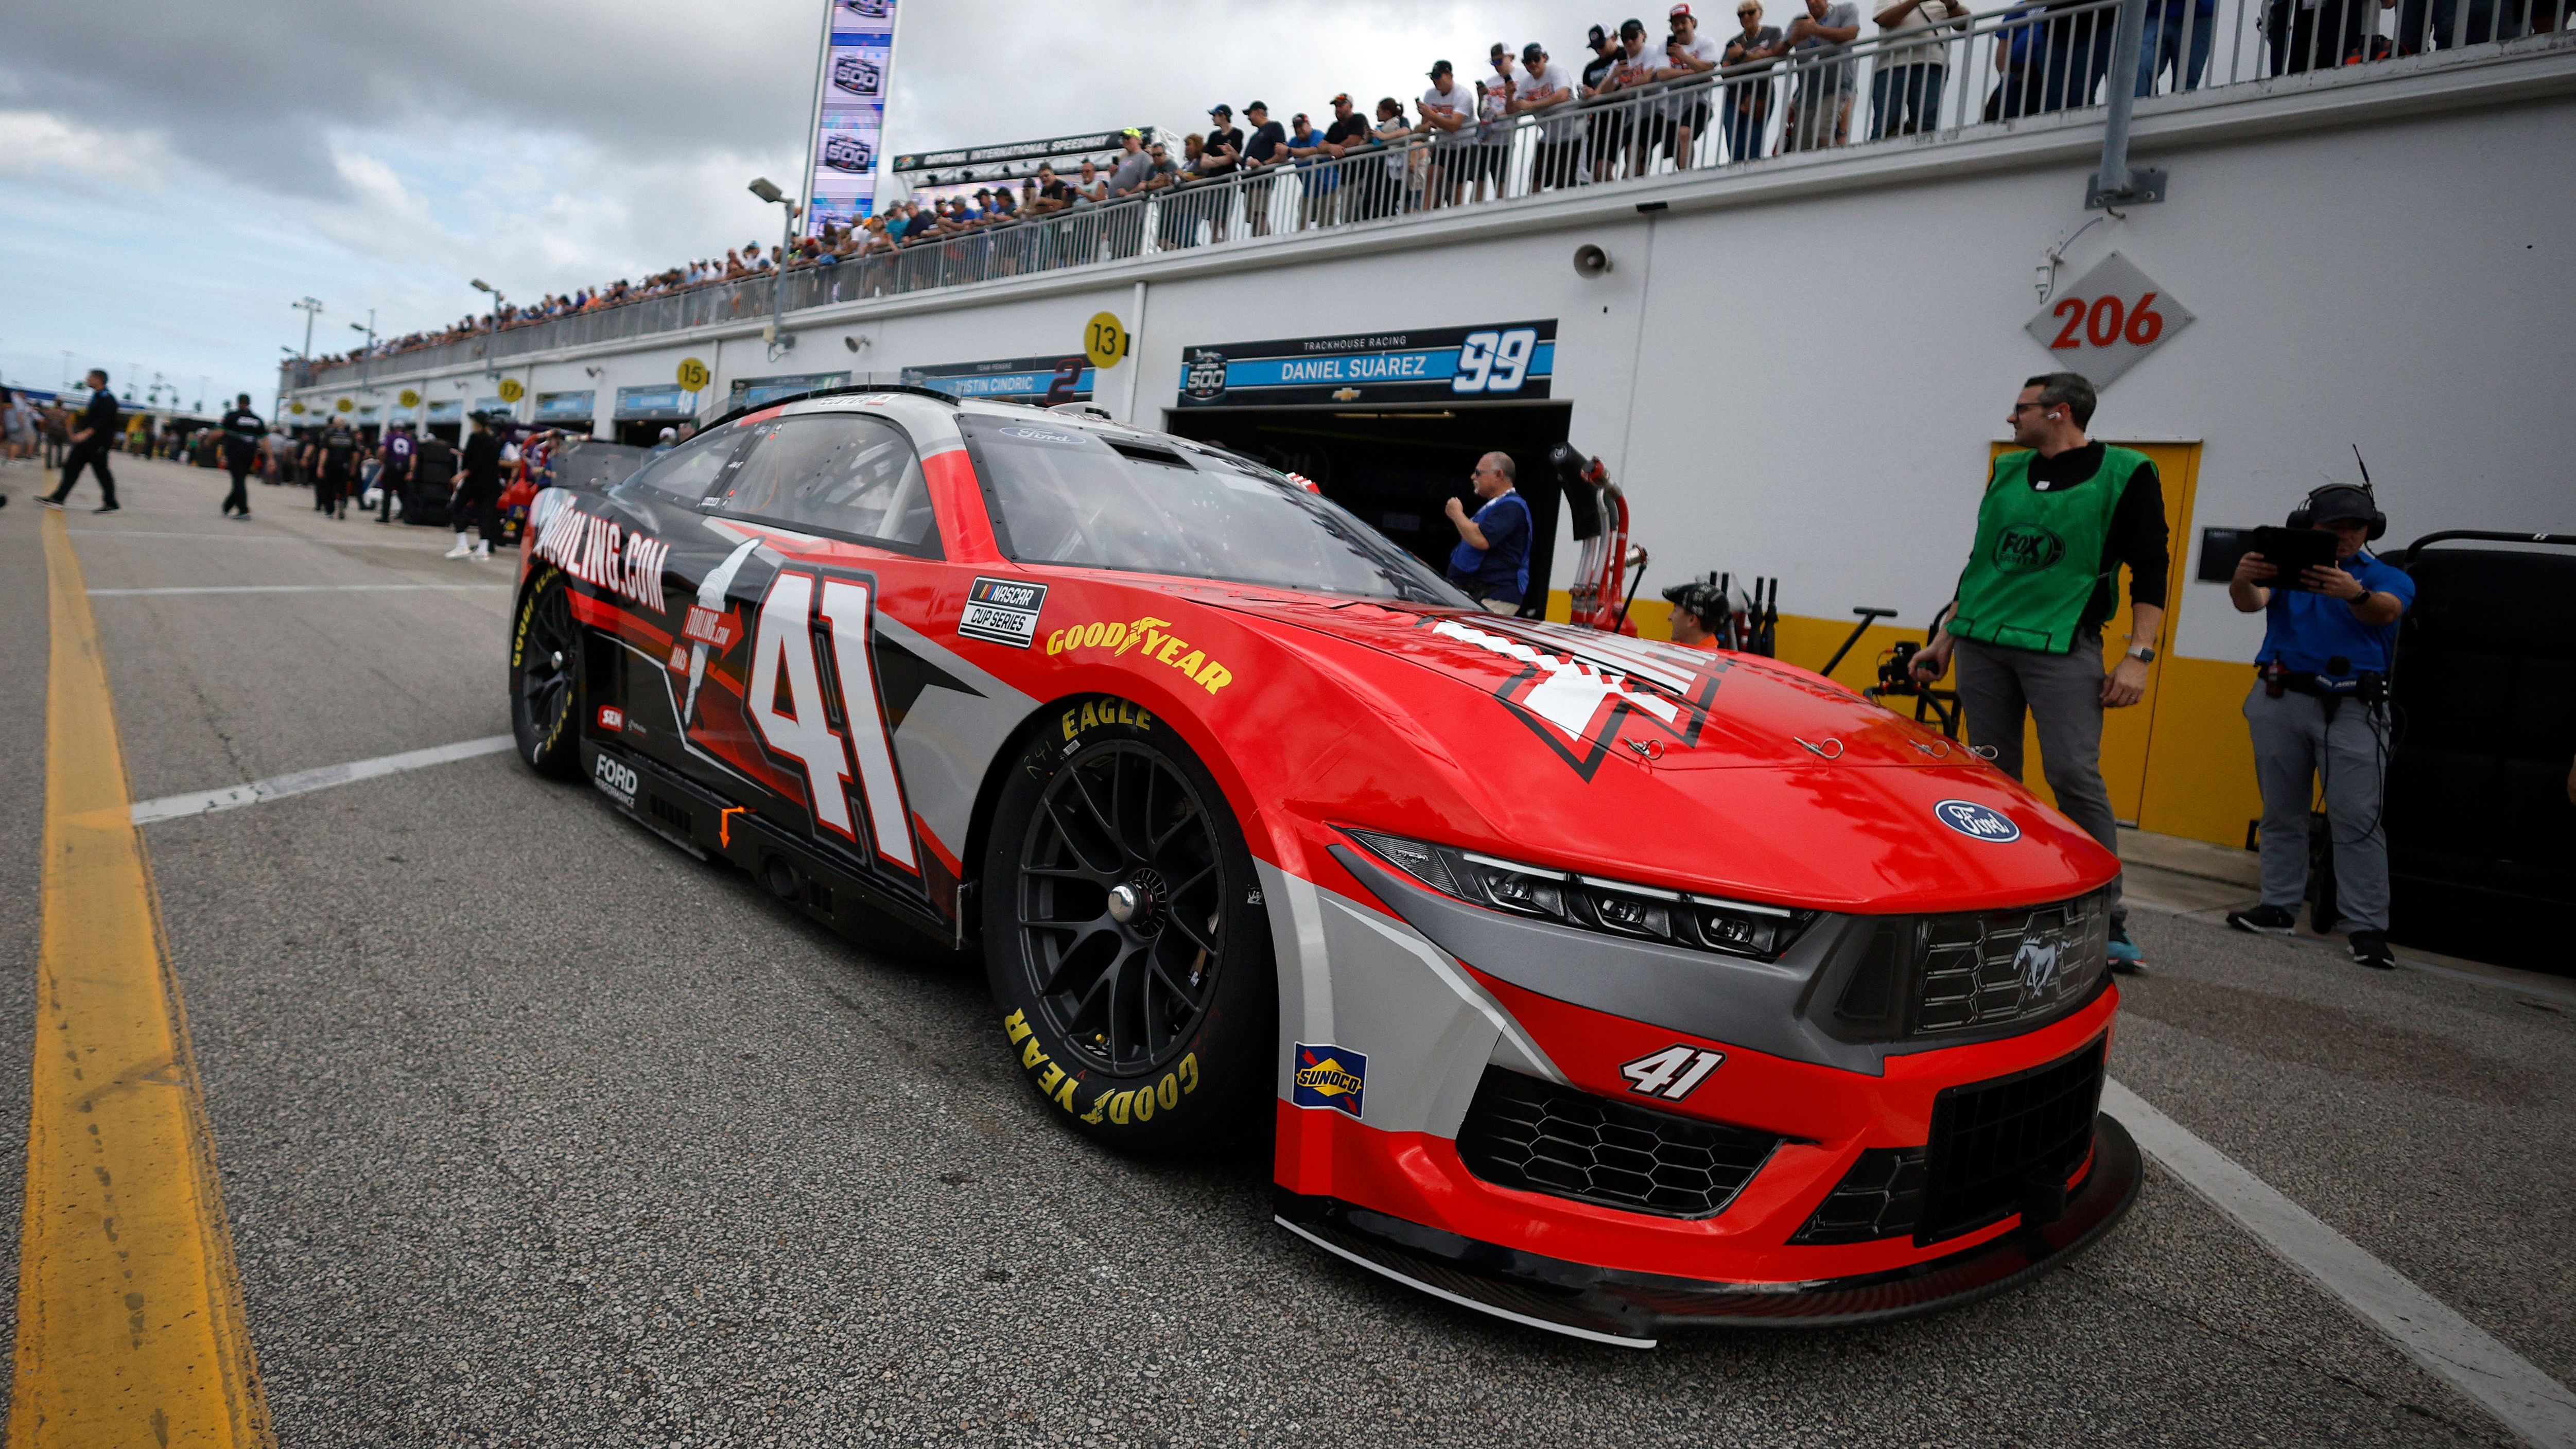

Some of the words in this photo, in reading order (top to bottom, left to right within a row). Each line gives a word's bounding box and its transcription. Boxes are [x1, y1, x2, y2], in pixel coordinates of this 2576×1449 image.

[837, 65, 878, 87] 500
[827, 144, 869, 166] 500
[970, 142, 1048, 161] INTERNATIONAL
[1050, 134, 1109, 152] SPEEDWAY
[2049, 292, 2163, 350] 206
[1093, 323, 1117, 355] 13
[1303, 338, 1366, 351] TRACKHOUSE
[1369, 335, 1407, 347] RACING
[1281, 360, 1345, 381] DANIEL
[1349, 350, 1426, 378] SUÁREZ
[1453, 328, 1537, 392] 99
[684, 363, 702, 384] 15
[990, 376, 1033, 392] CINDRIC
[1046, 357, 1084, 406] 2
[1188, 370, 1225, 388] 500
[1019, 428, 1071, 443] Ford
[2003, 532, 2044, 556] FOX
[990, 583, 1035, 606] NASCAR
[970, 607, 991, 624] CUP
[990, 610, 1026, 632] SERIES
[747, 569, 919, 875] 41
[1062, 696, 1151, 742] EAGLE
[596, 753, 638, 796] FORD
[1949, 805, 2009, 835] Ford
[1297, 1070, 1363, 1094] SUNOCO
[1622, 1045, 1724, 1100] 41
